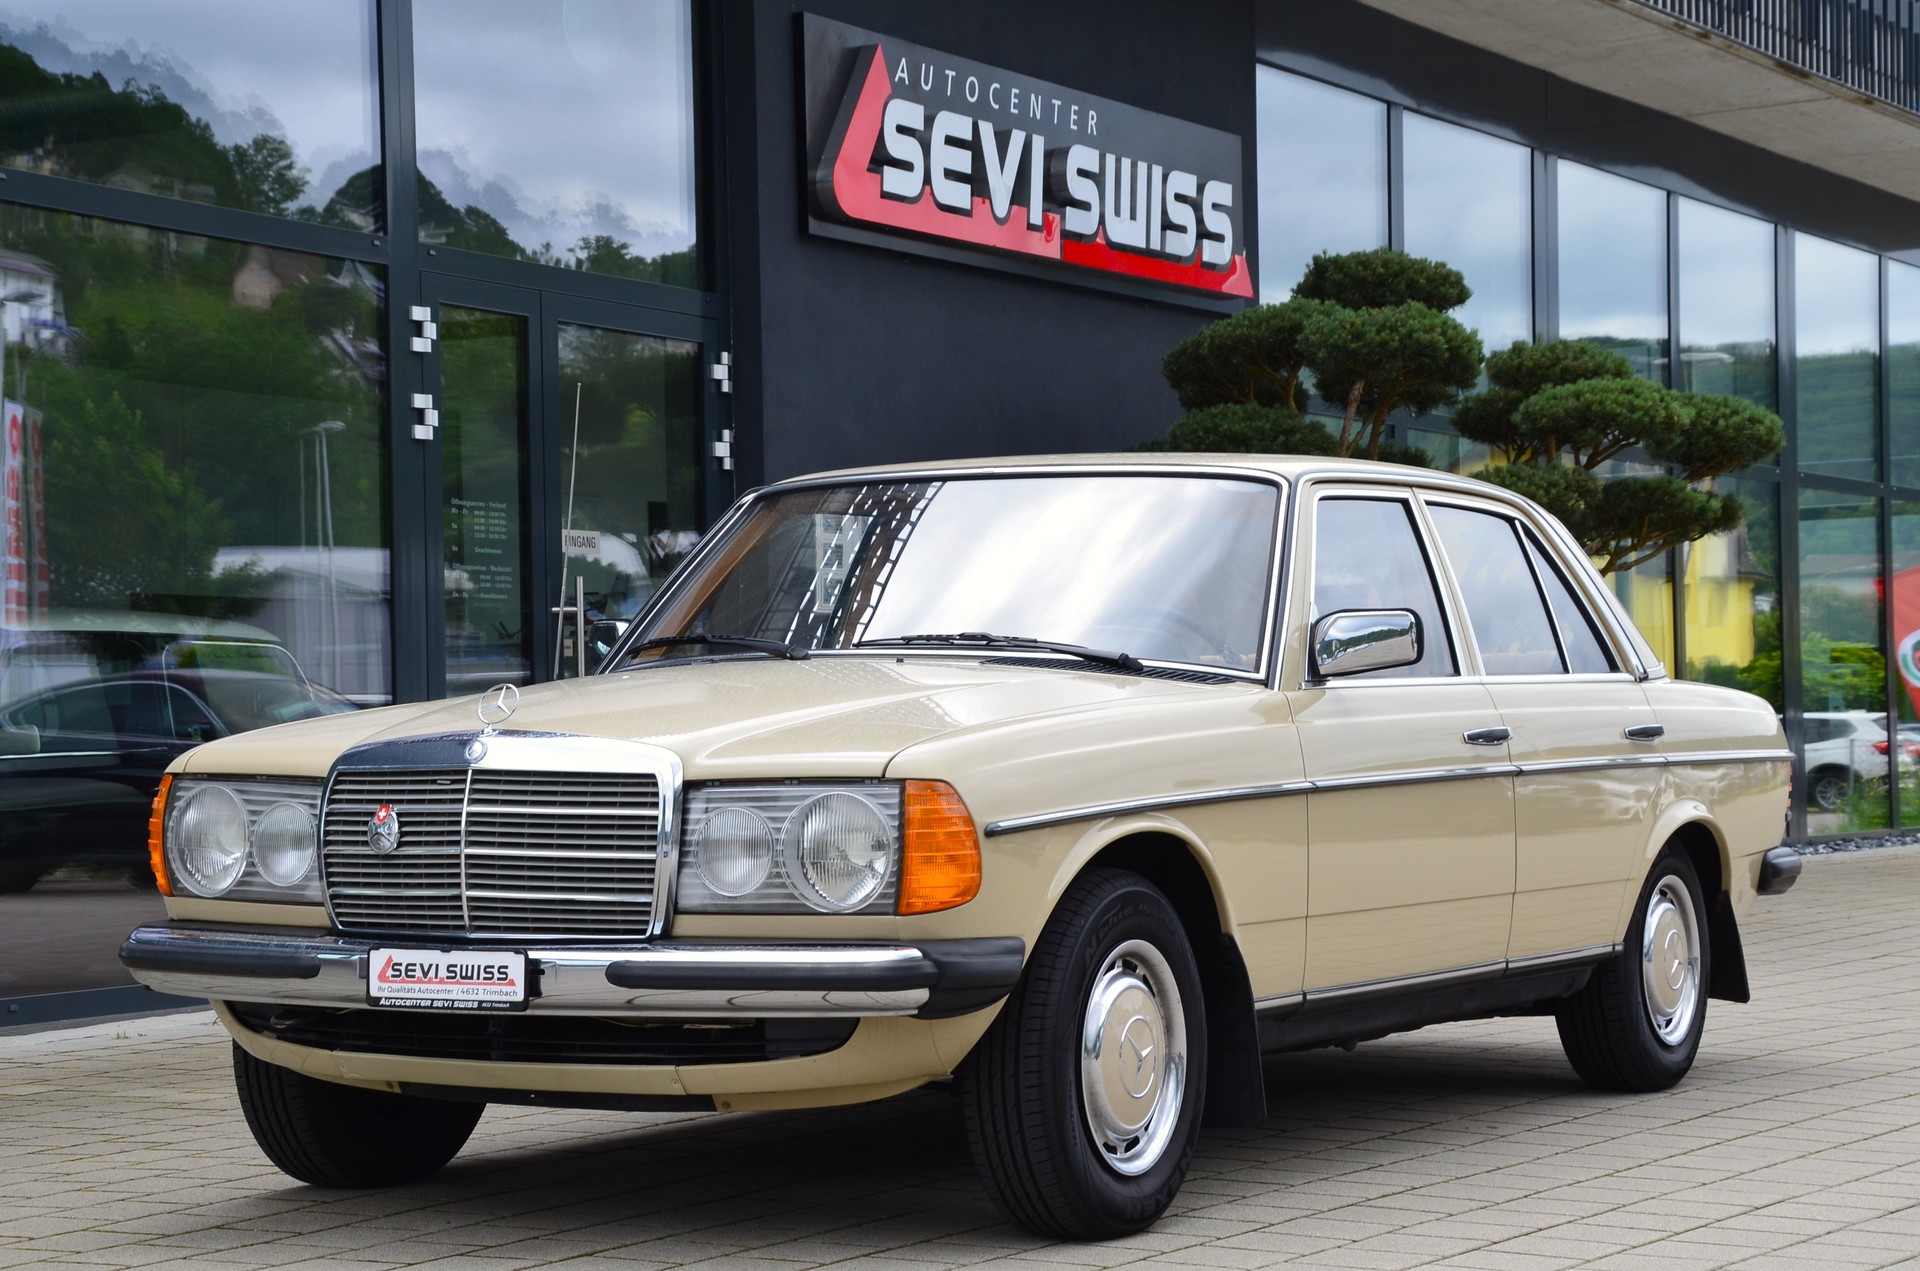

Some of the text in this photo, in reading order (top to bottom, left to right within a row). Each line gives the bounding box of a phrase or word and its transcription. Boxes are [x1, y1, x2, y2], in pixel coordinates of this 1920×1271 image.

[895, 57, 1097, 136] AUTOCENTER
[883, 98, 1233, 265] SEVI SWISS
[386, 986, 416, 994] Qualitäts
[417, 987, 454, 995] Autocenter
[482, 989, 518, 997] Trimbach
[390, 962, 508, 982] SEVI SWISS
